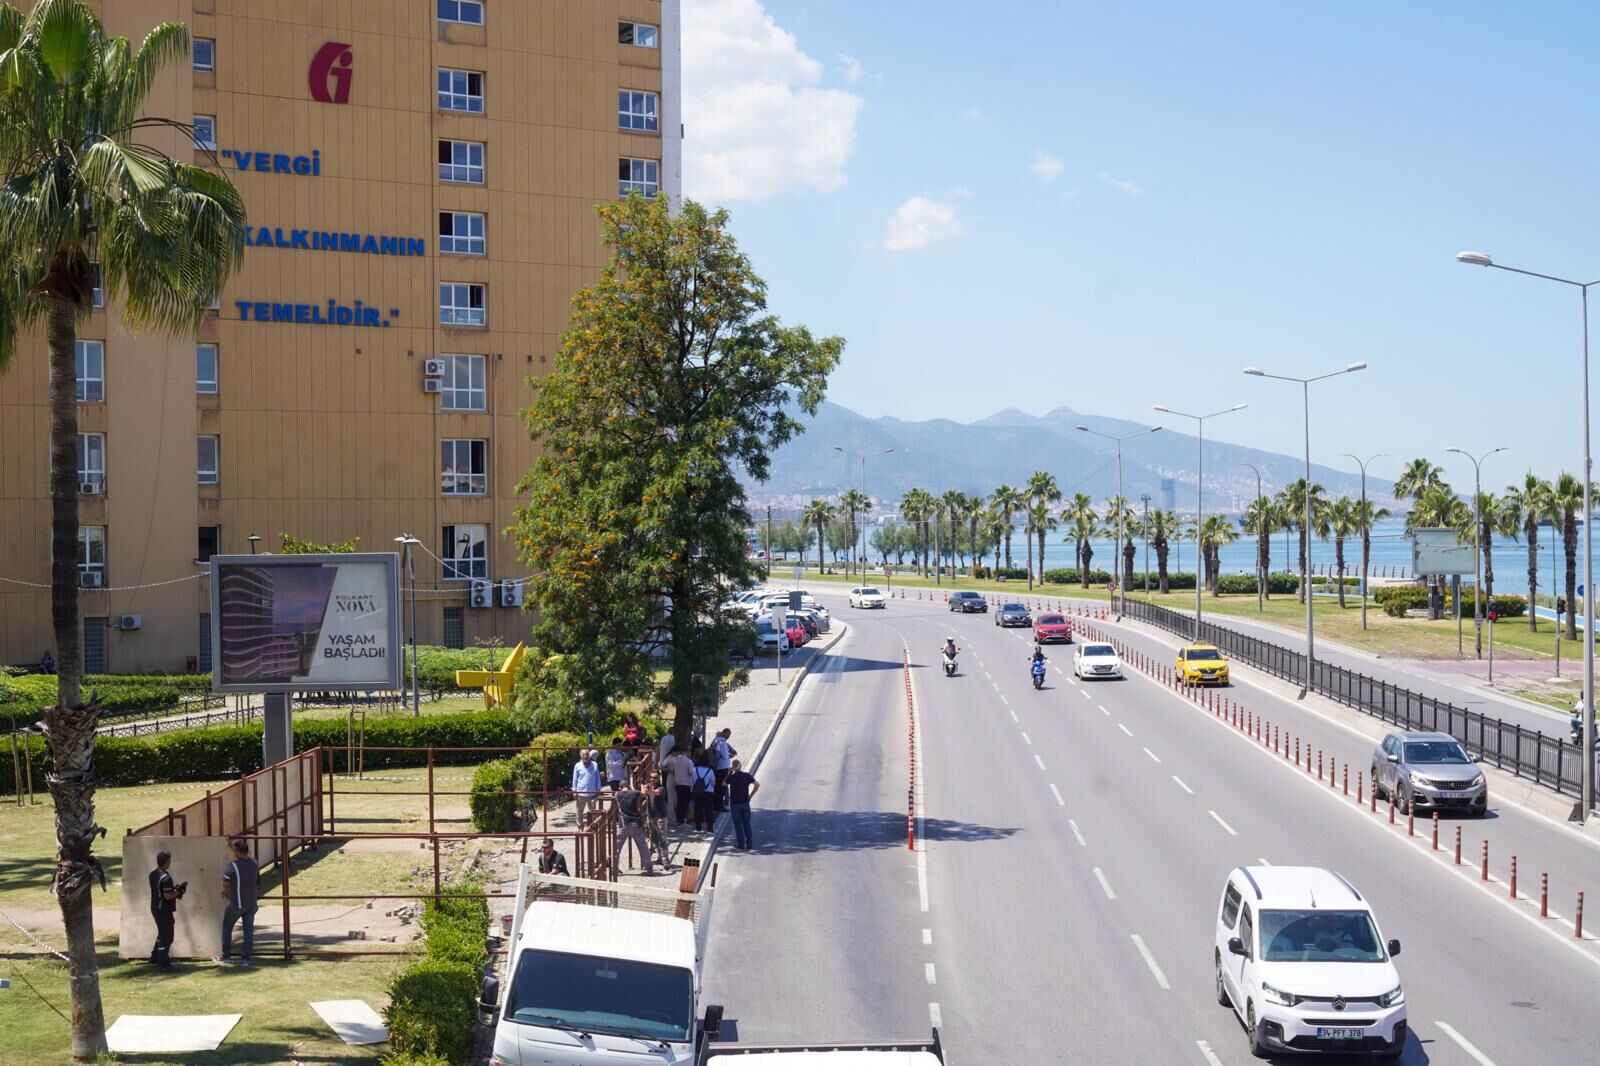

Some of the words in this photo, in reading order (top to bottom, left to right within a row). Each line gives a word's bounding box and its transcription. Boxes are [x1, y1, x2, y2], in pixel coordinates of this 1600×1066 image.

[336, 600, 376, 613] NOVA
[329, 634, 375, 647] YAŞAM
[324, 647, 385, 661] BAŞLADI!
